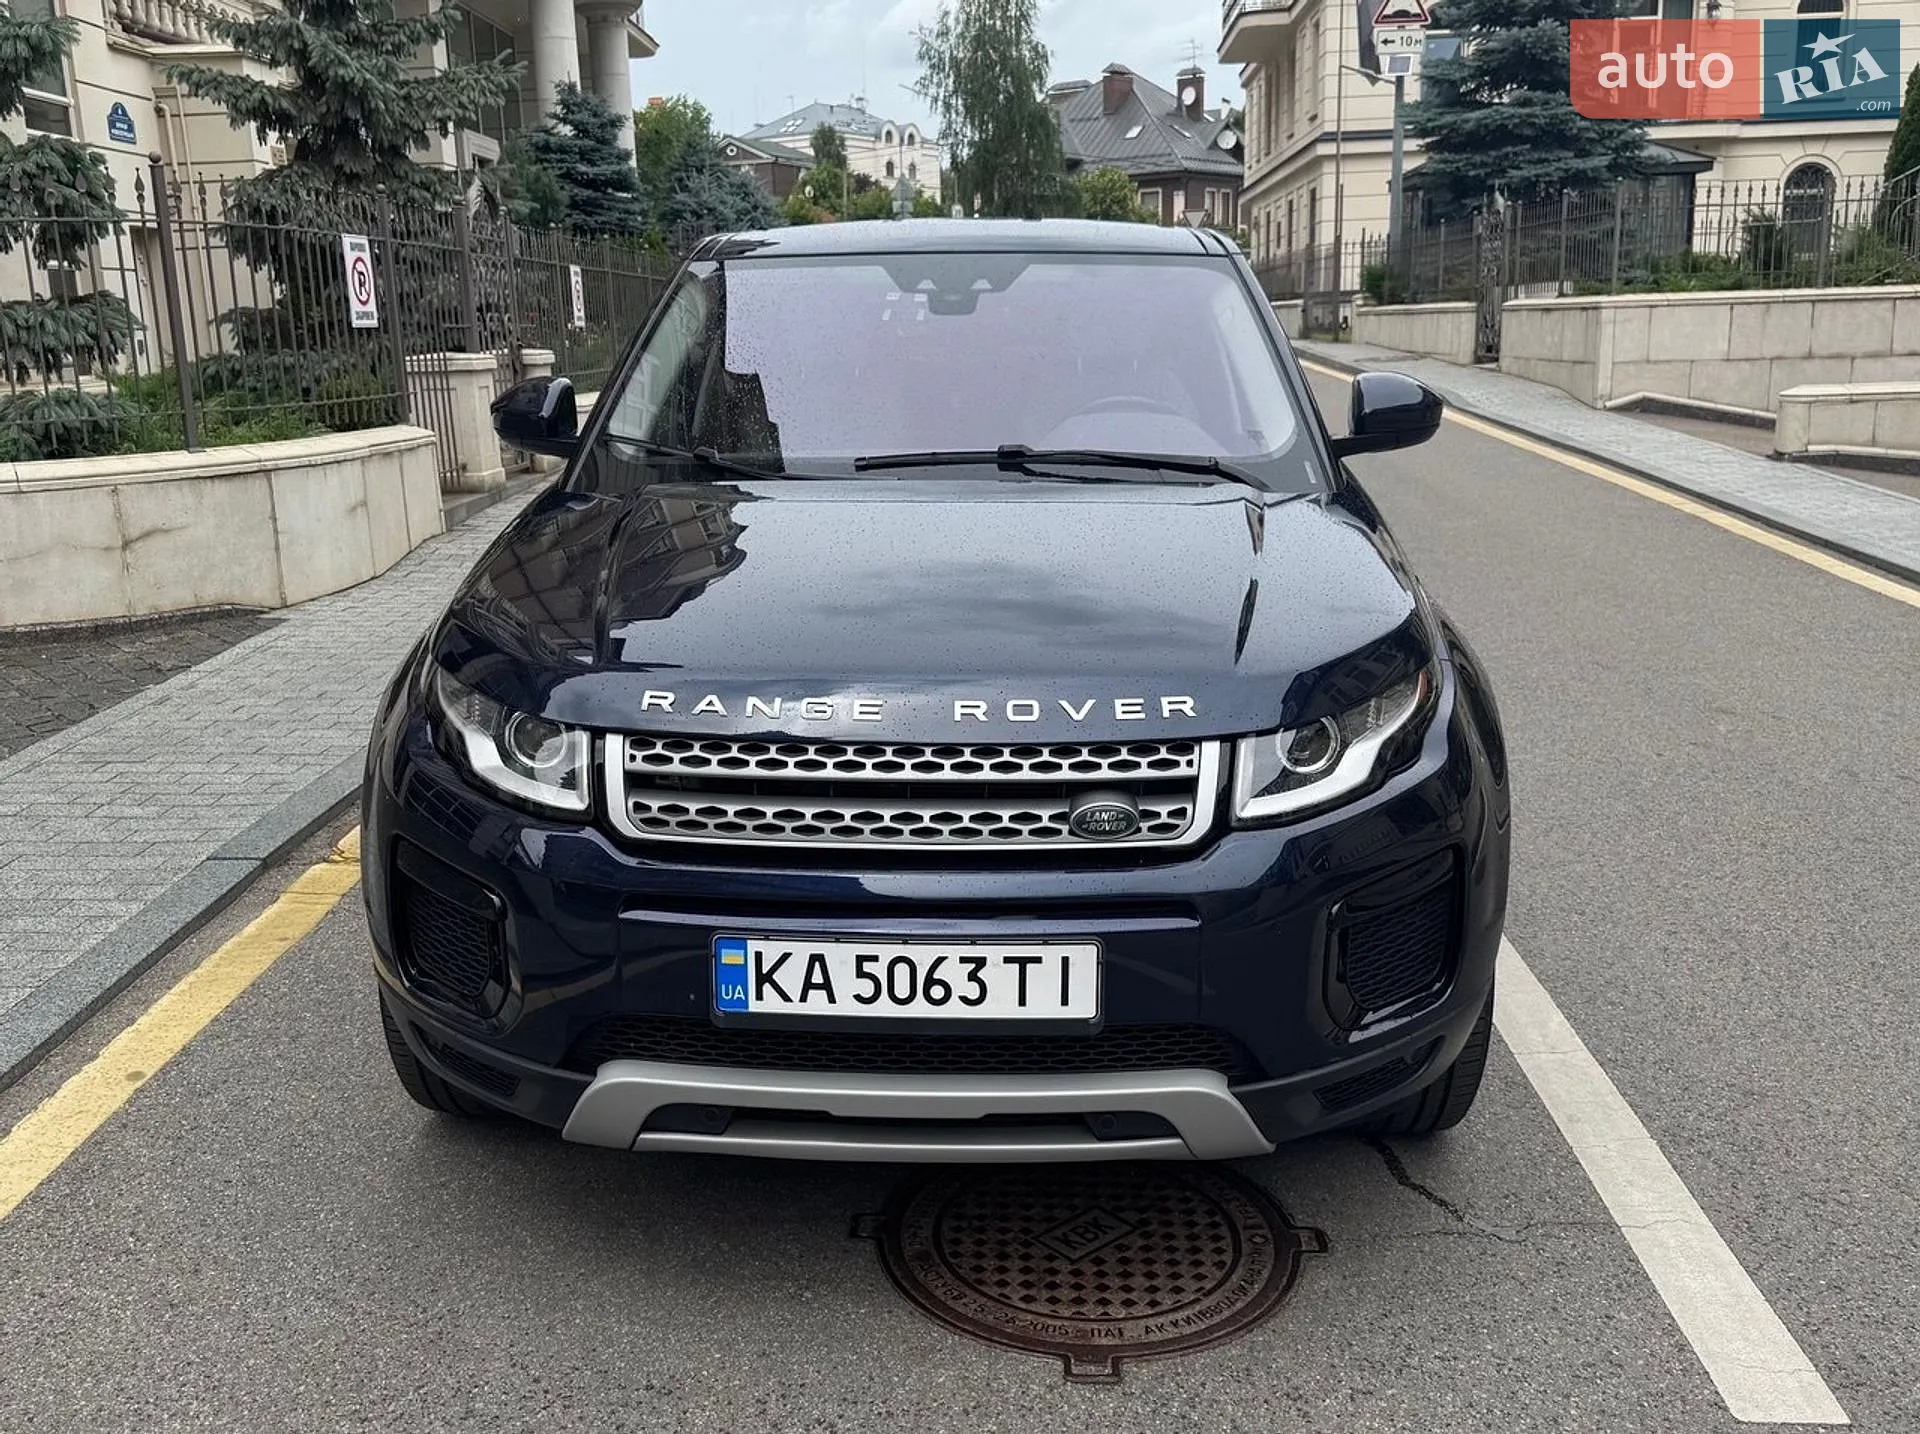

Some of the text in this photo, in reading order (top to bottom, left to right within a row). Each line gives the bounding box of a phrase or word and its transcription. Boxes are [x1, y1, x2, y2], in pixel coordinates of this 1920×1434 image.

[640, 689, 1198, 721] RANGE ROVER
[1086, 811, 1118, 822] LAND
[1088, 820, 1127, 832] ROVER
[754, 950, 1070, 1008] KA 5063 TI
[721, 984, 745, 1001] UA
